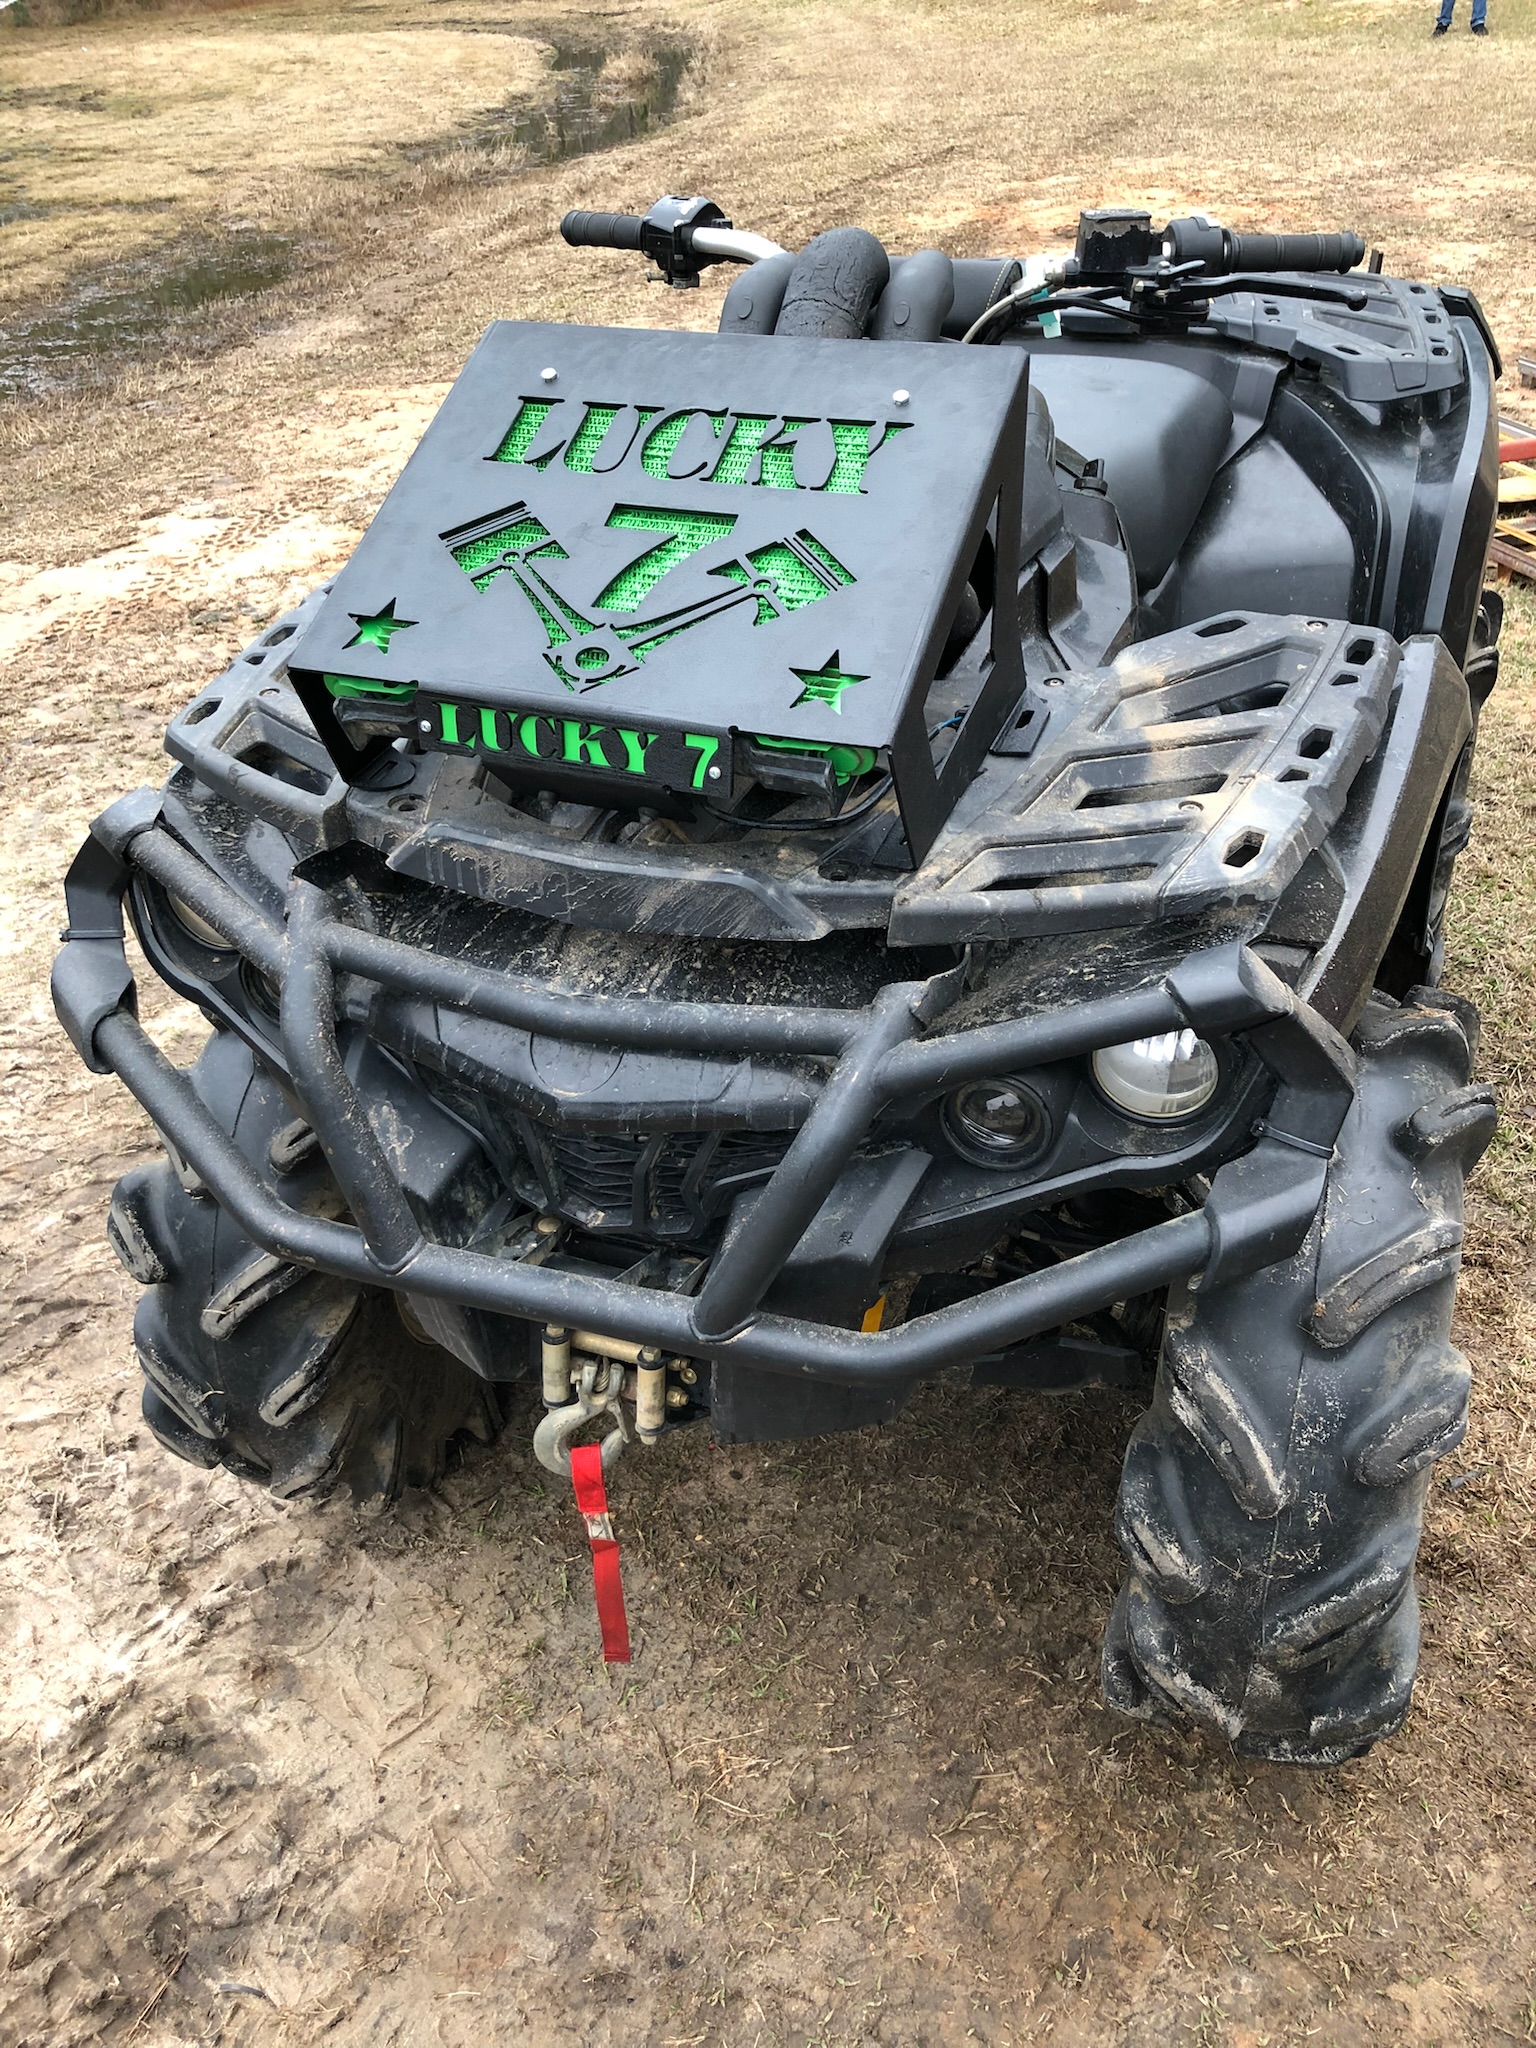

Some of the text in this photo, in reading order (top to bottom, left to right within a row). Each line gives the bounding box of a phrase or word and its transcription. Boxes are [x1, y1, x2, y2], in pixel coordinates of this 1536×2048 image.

[483, 396, 914, 494] LUCKY
[591, 503, 739, 613] 7
[434, 702, 719, 788] LUCKY 7
